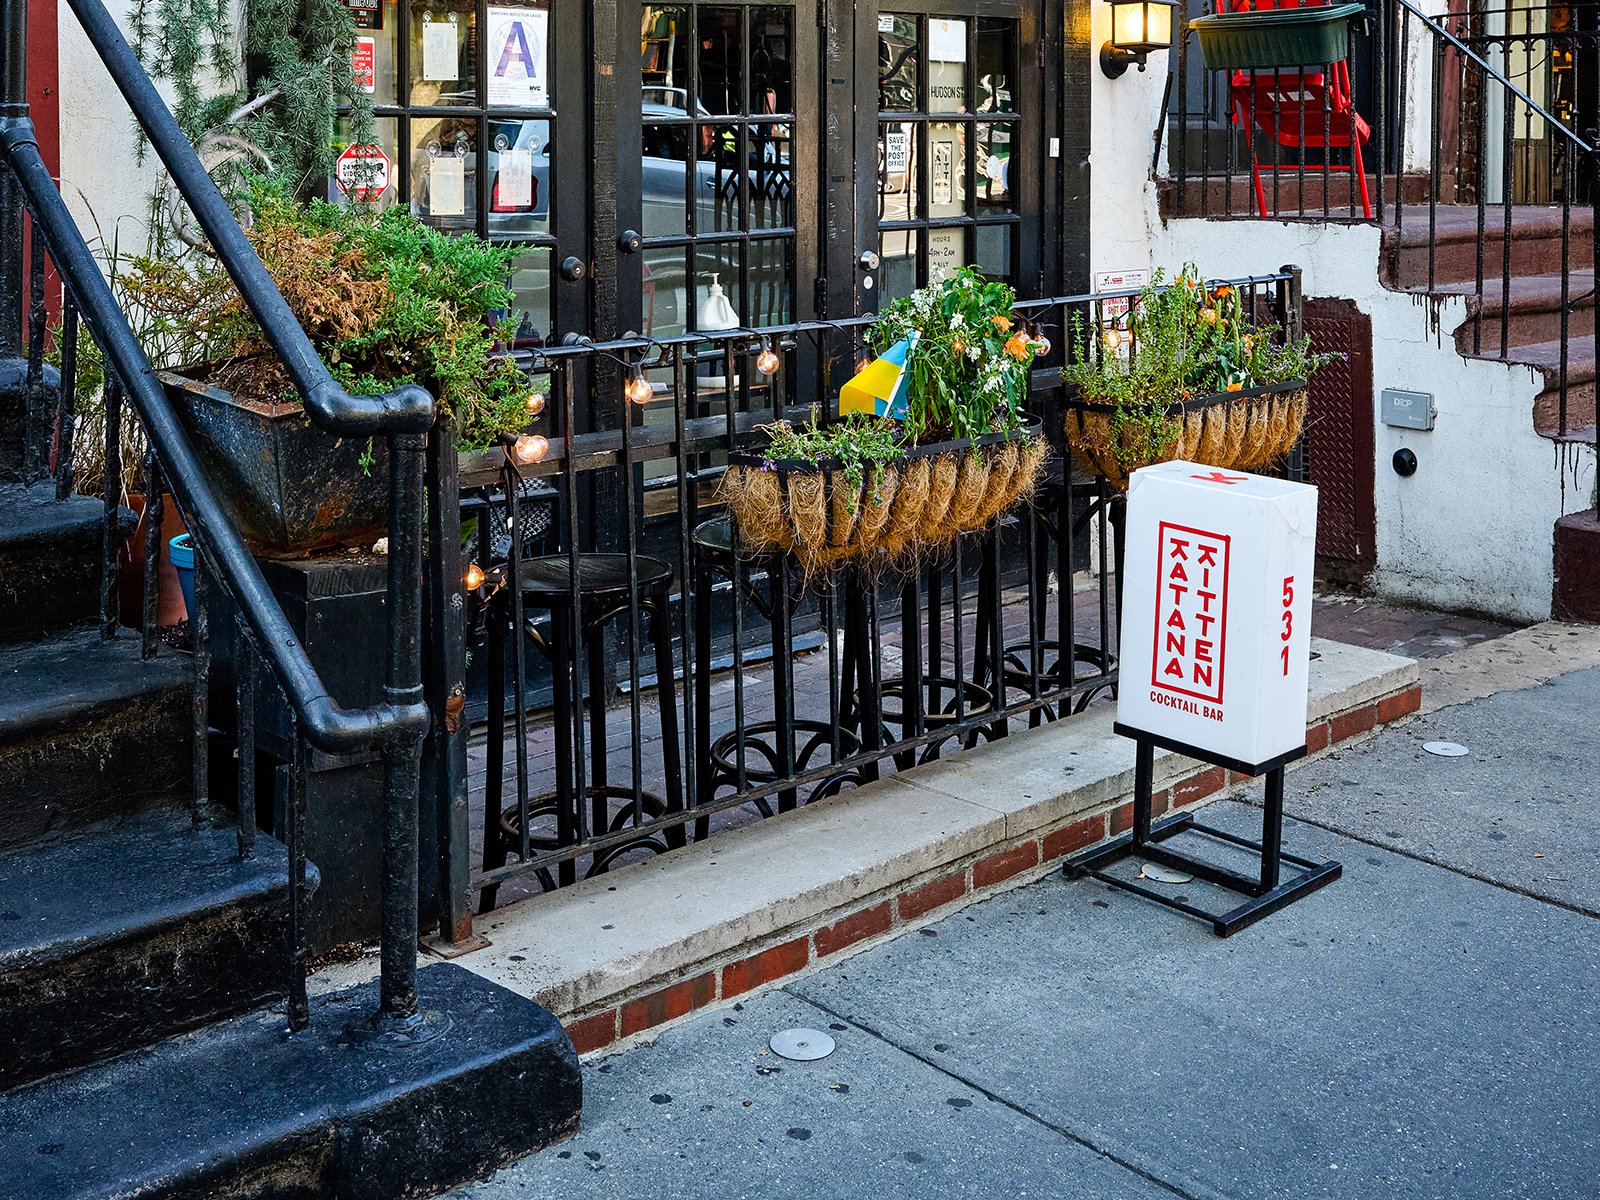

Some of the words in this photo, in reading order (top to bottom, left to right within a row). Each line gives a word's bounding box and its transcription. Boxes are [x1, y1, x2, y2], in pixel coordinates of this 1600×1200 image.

[494, 20, 537, 78] A
[930, 86, 955, 98] HUDSON
[888, 136, 904, 144] SAVE
[1164, 537, 1190, 679] KATANA
[1193, 543, 1218, 688] KITTEN
[1281, 575, 1295, 677] 531
[1150, 690, 1200, 716] COCKTAIL
[1203, 706, 1224, 723] BAR
